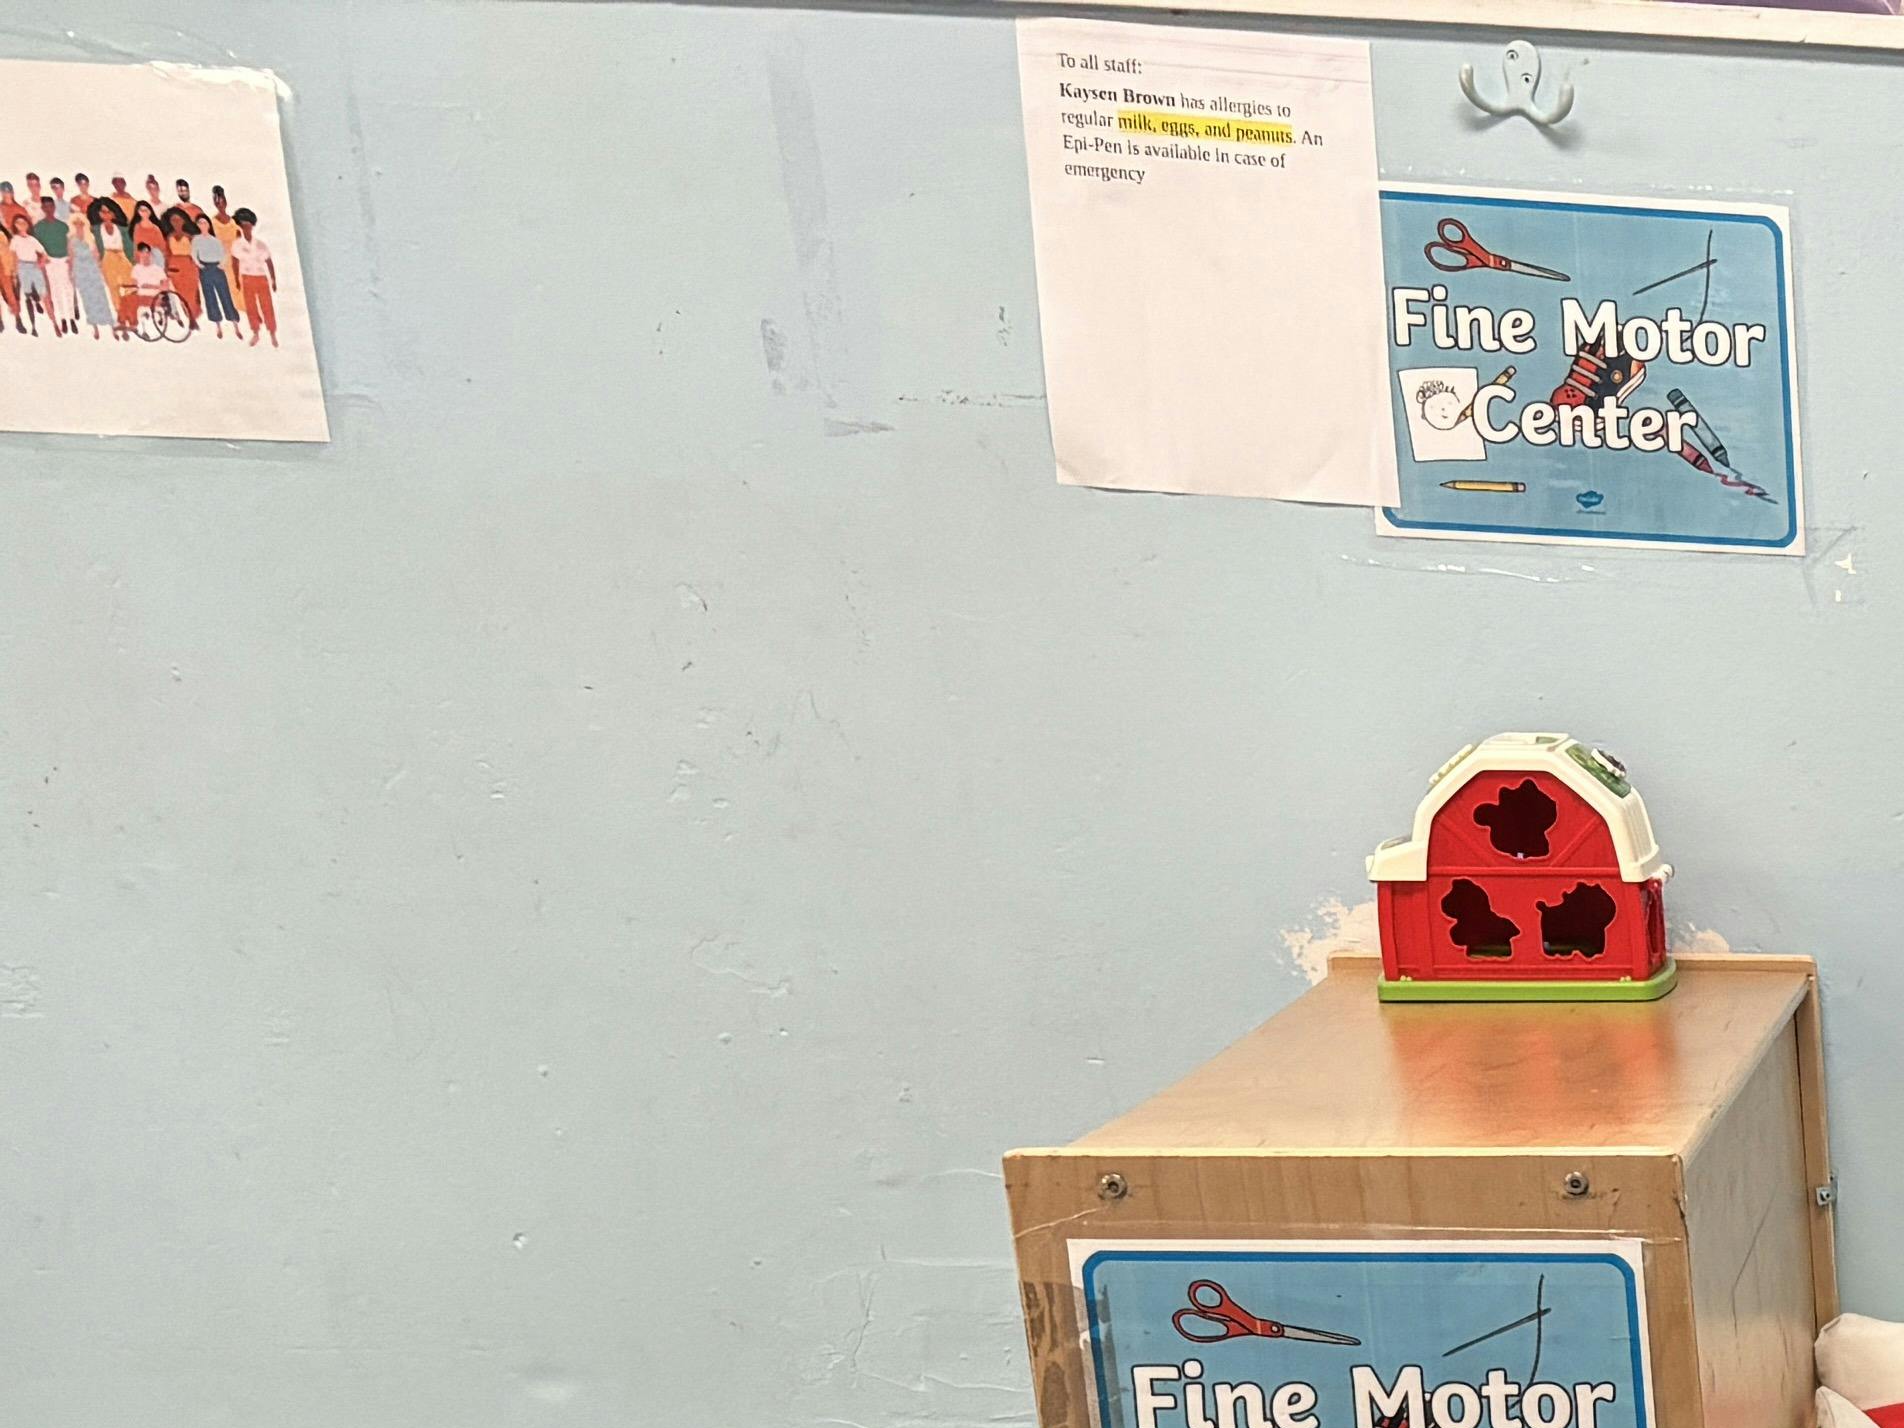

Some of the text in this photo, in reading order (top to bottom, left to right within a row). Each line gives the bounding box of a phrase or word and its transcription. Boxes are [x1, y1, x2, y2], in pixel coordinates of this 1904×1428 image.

[1057, 52, 1143, 74] To all staff:
[1123, 88, 1176, 108] Brown
[1180, 93, 1204, 110] has
[1209, 96, 1272, 118] allergies
[1276, 104, 1291, 118] to
[1061, 111, 1323, 146] regular milk, eggs, and peanuts. An
[1063, 134, 1286, 169] Epi-Pen is available in case of
[1064, 163, 1145, 184] emergency
[1392, 285, 1765, 367] Fine Motor
[1471, 383, 1698, 454] Center
